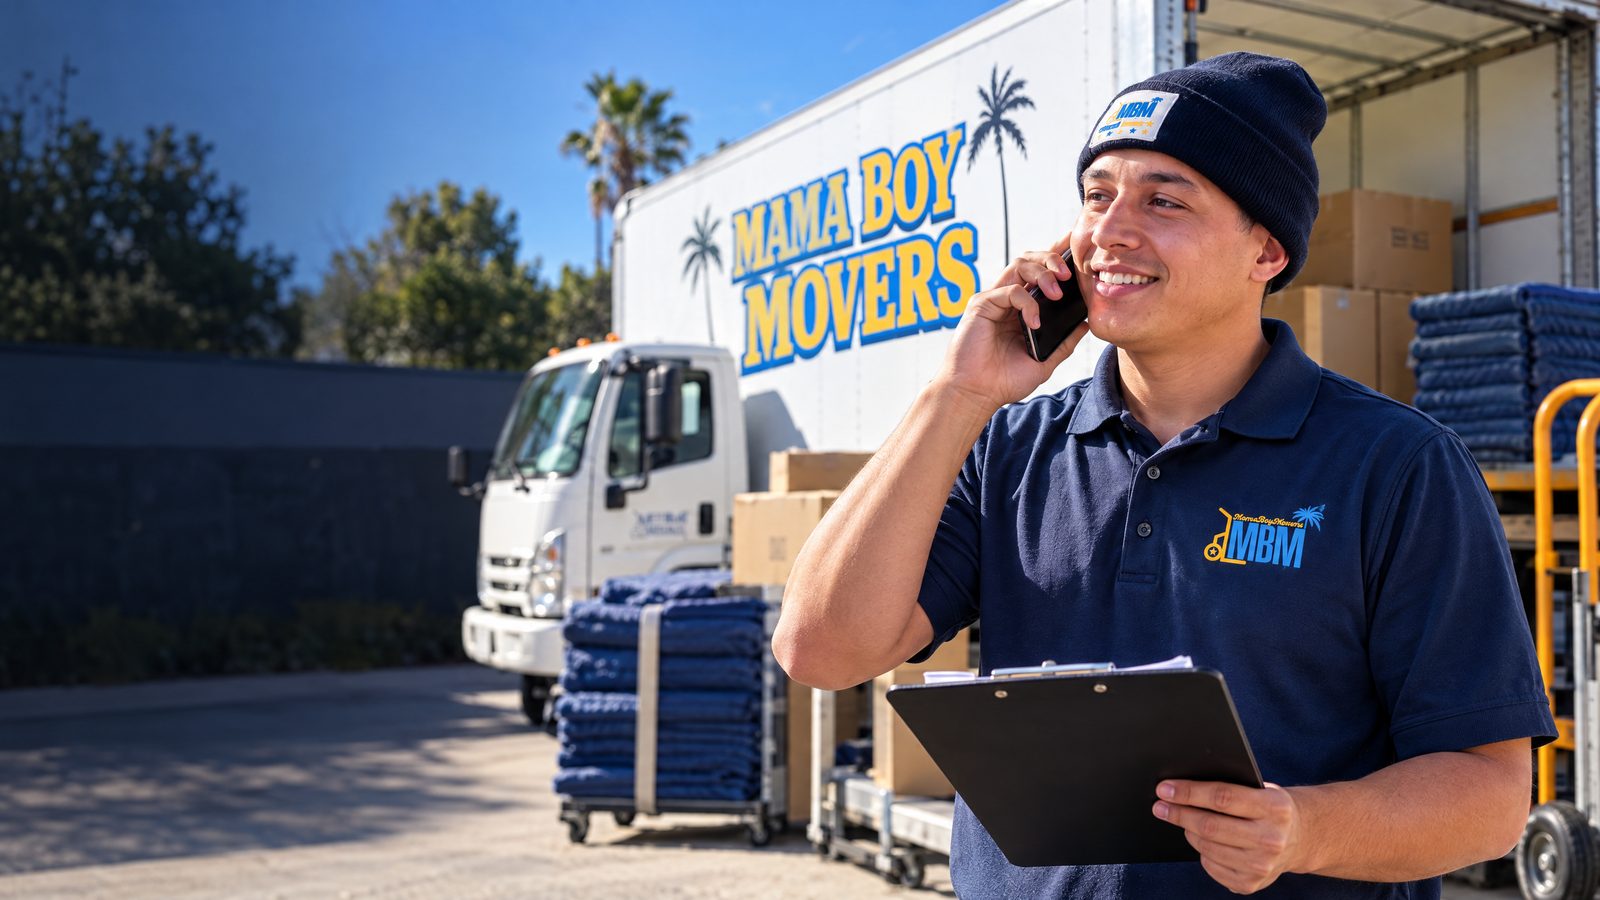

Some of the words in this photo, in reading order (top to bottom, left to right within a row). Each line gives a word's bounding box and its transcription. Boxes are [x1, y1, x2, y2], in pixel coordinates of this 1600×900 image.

[1116, 102, 1158, 119] MBM
[731, 167, 853, 285] MAMA
[859, 121, 966, 243] BOY
[740, 221, 980, 376] MOVERS
[1227, 521, 1306, 568] MBM
